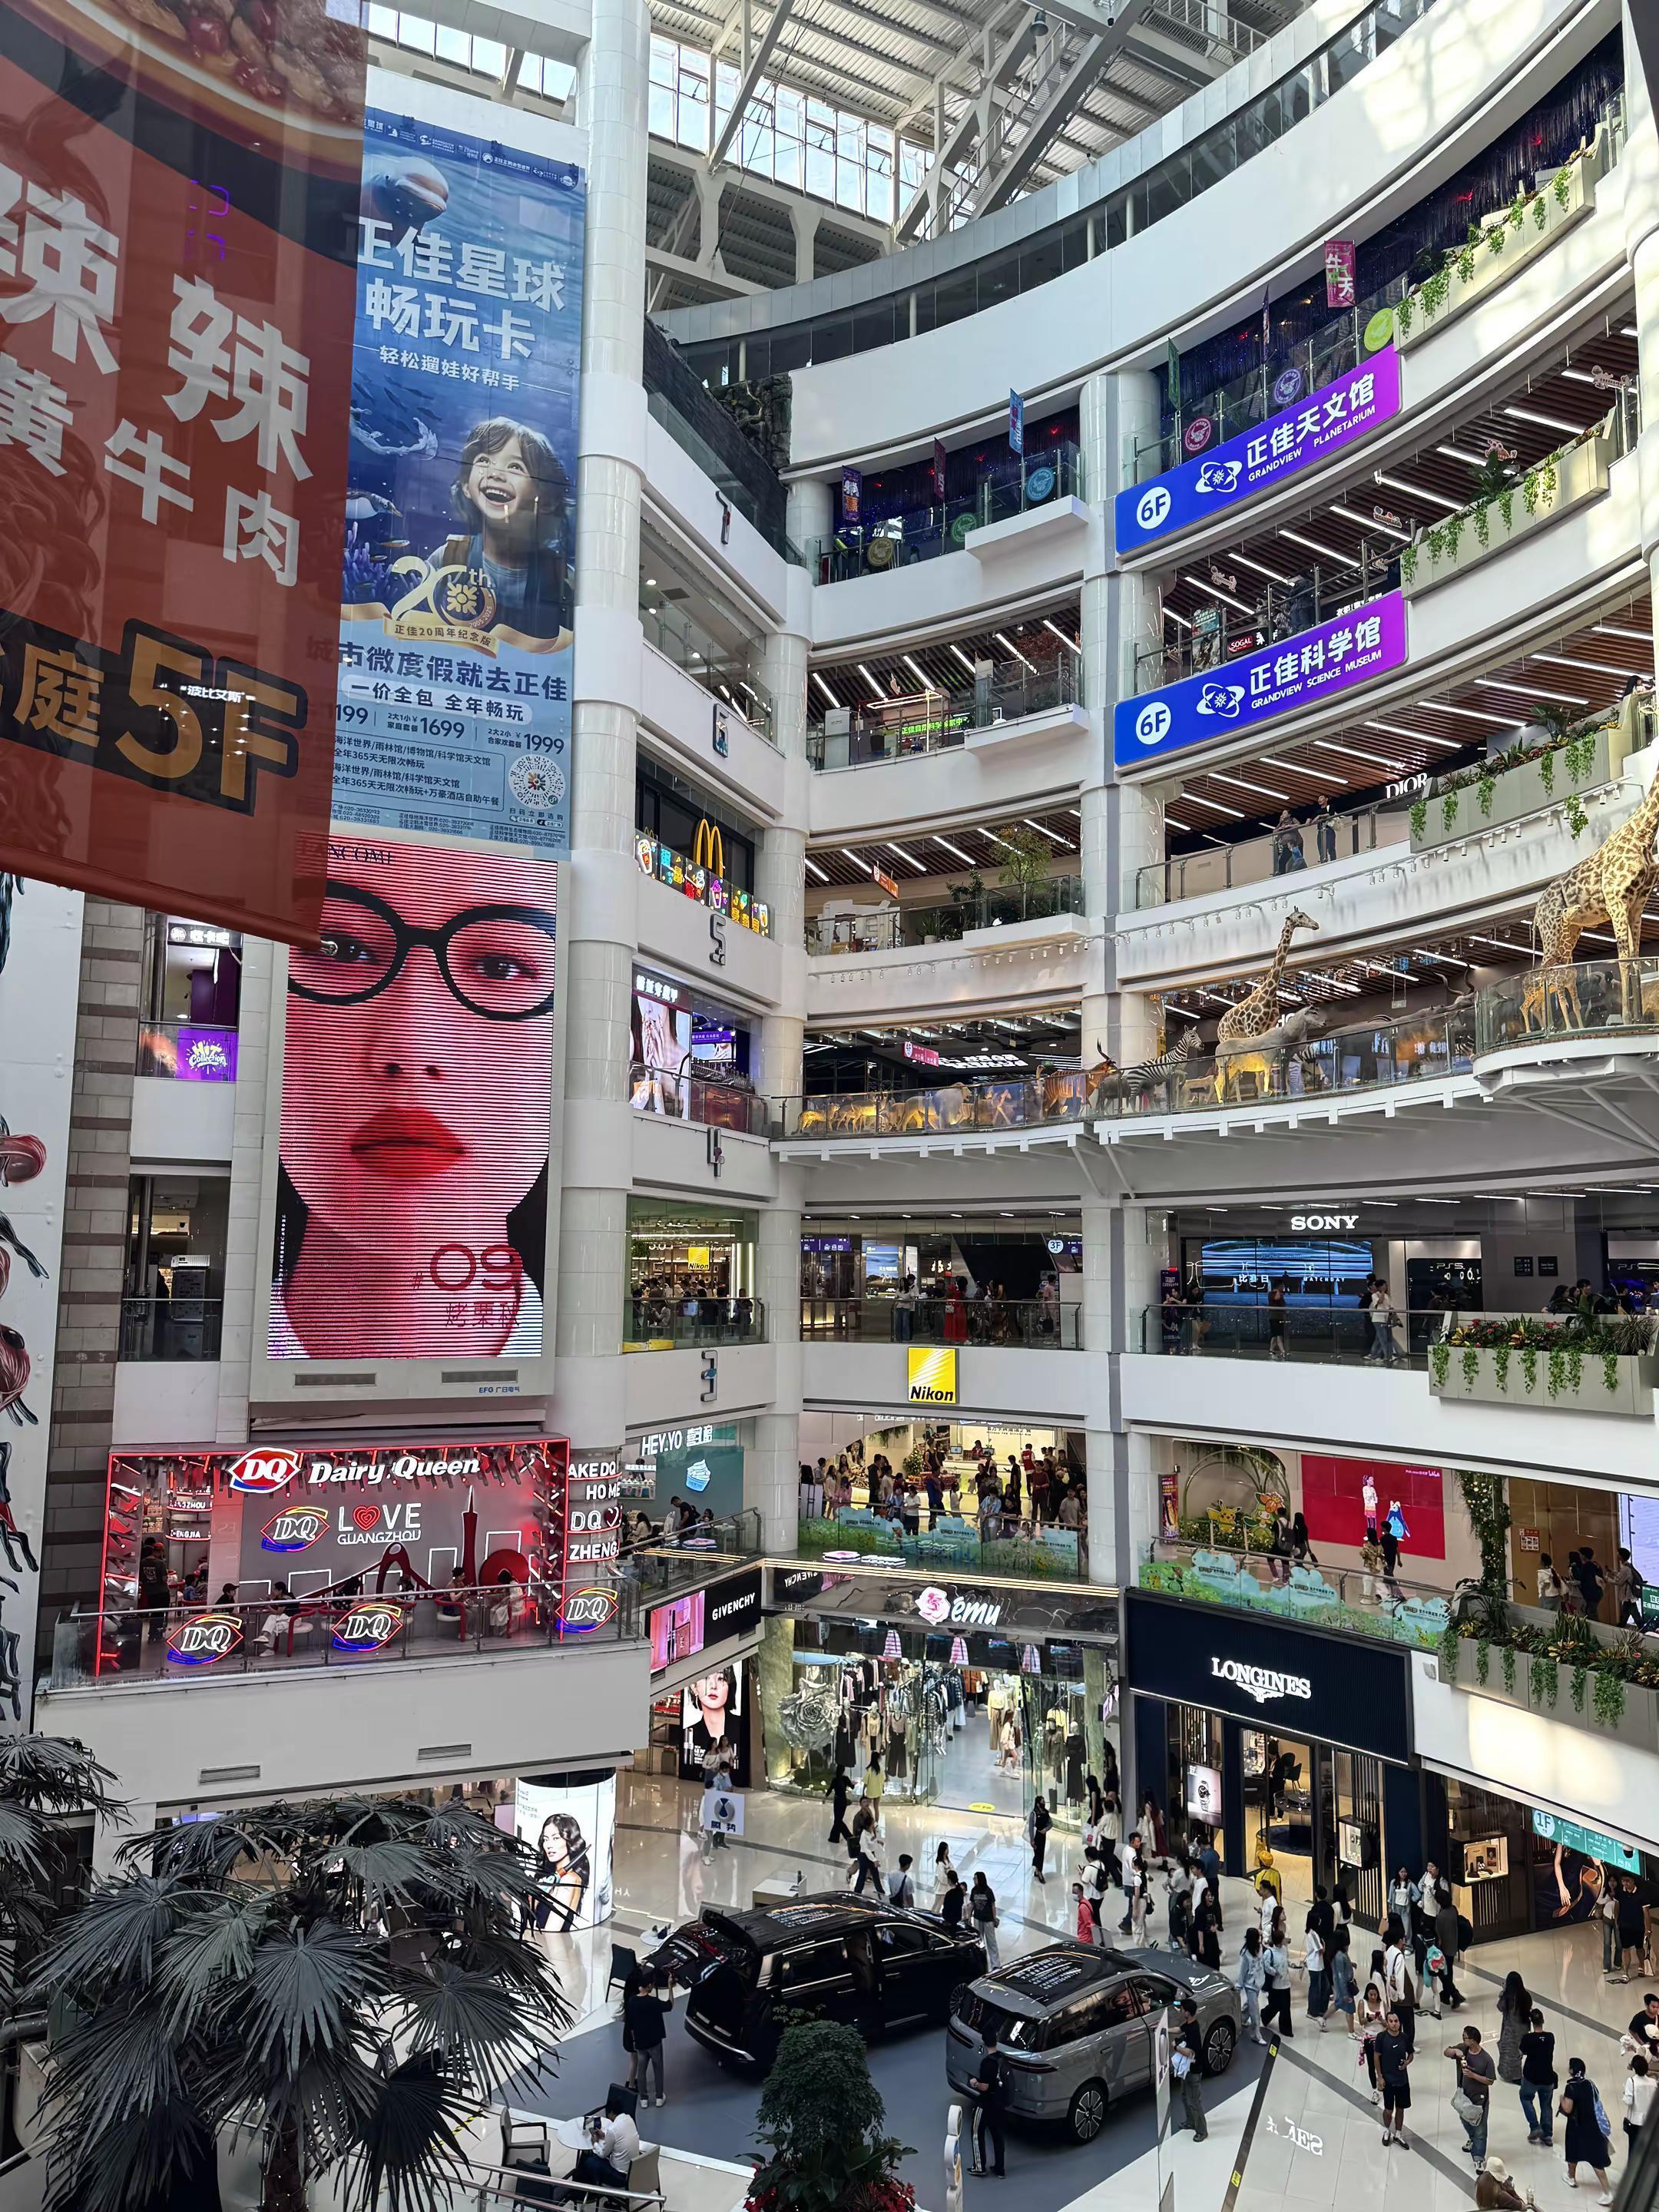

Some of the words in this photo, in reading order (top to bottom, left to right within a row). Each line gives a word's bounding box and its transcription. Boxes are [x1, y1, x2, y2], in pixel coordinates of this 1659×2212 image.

[358, 216, 566, 313] 正佳星球
[366, 277, 535, 359] 畅玩卡
[379, 345, 520, 392] 轻松遛娃好帮手
[1247, 373, 1375, 469] 正佳天文馆
[1248, 446, 1303, 482] GRANDVIEW
[1313, 404, 1376, 448] PLANETARIUM
[1140, 492, 1167, 522] 6F
[394, 624, 492, 647] 正佳20周年纪念版
[1230, 637, 1253, 650] SOGAL
[1250, 615, 1381, 696] 正佳科学馆
[1251, 683, 1303, 710] GRANDVIEW
[1307, 667, 1341, 688] SCIENCE
[1346, 650, 1382, 673] MUSEUM
[350, 682, 433, 707] 一价全包
[445, 694, 524, 722] 全年畅玩
[115, 633, 298, 801] 5F
[387, 721, 419, 732] 家庭套餐
[420, 717, 465, 739] 1699
[1140, 710, 1167, 738] 6F
[488, 737, 522, 749] 合家欢套餐
[524, 733, 565, 754] 1999
[334, 748, 426, 769] 全年365天无限次畅玩
[1386, 773, 1428, 798] DIOR
[509, 808, 564, 821] 扫码立即选购
[1291, 1216, 1359, 1230] SONY
[1050, 1241, 1061, 1250] 3F
[911, 1386, 953, 1401] Nikon
[642, 1431, 682, 1456] HEY.YO
[243, 1459, 287, 1481] DQ
[309, 1462, 385, 1484] Dairy
[393, 1456, 478, 1476] Queen
[586, 1482, 621, 1500] HOME
[273, 1518, 320, 1540] DQ
[571, 1510, 602, 1532] DQ
[337, 1530, 421, 1545] GUANGZHOU
[566, 1597, 608, 1622] DQ
[712, 1592, 755, 1621] GIVENCHY
[180, 1627, 230, 1651] DQ
[344, 1615, 392, 1641] DQ
[1211, 1657, 1312, 1699] LONGINES
[1537, 1813, 1551, 1827] 1F
